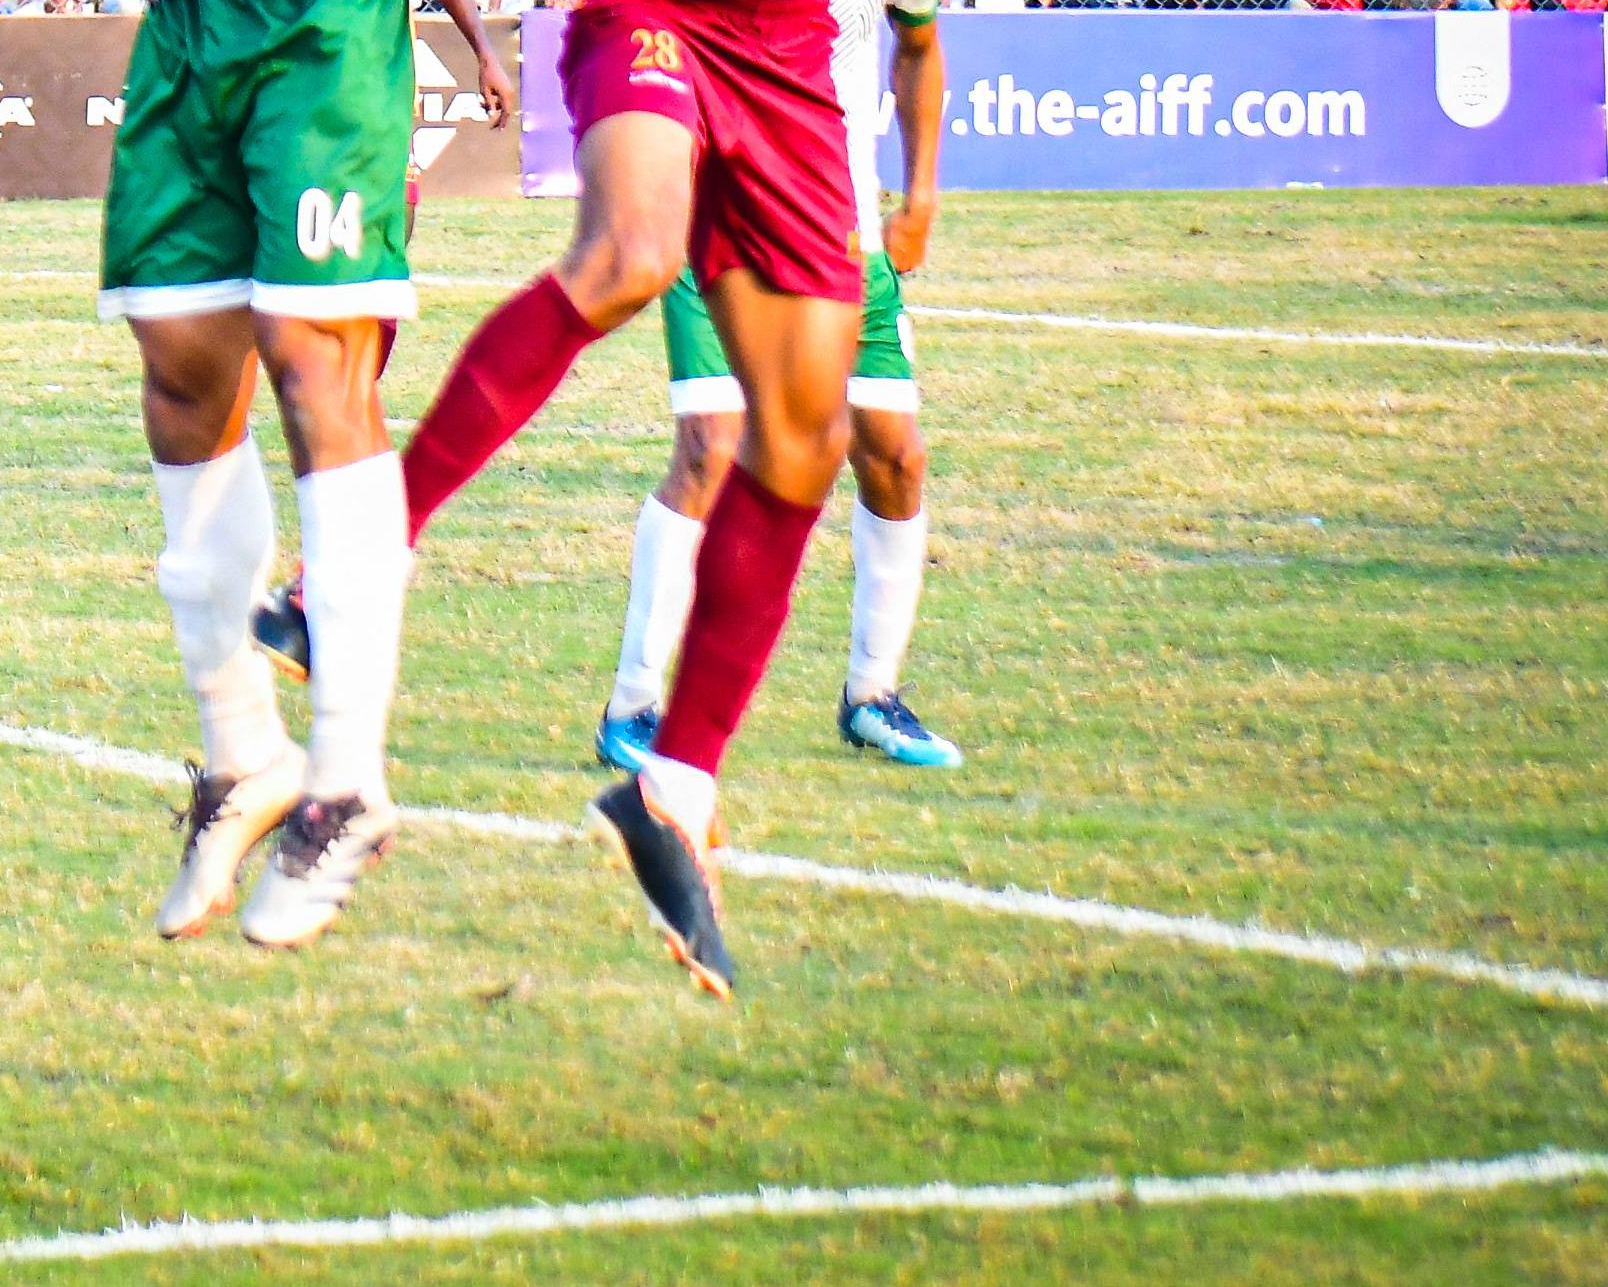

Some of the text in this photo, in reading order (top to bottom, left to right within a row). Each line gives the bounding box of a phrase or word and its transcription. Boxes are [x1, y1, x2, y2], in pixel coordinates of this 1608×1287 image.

[630, 28, 681, 72] 28
[874, 73, 1367, 137] .the-aiff.com
[296, 187, 362, 261] 04
